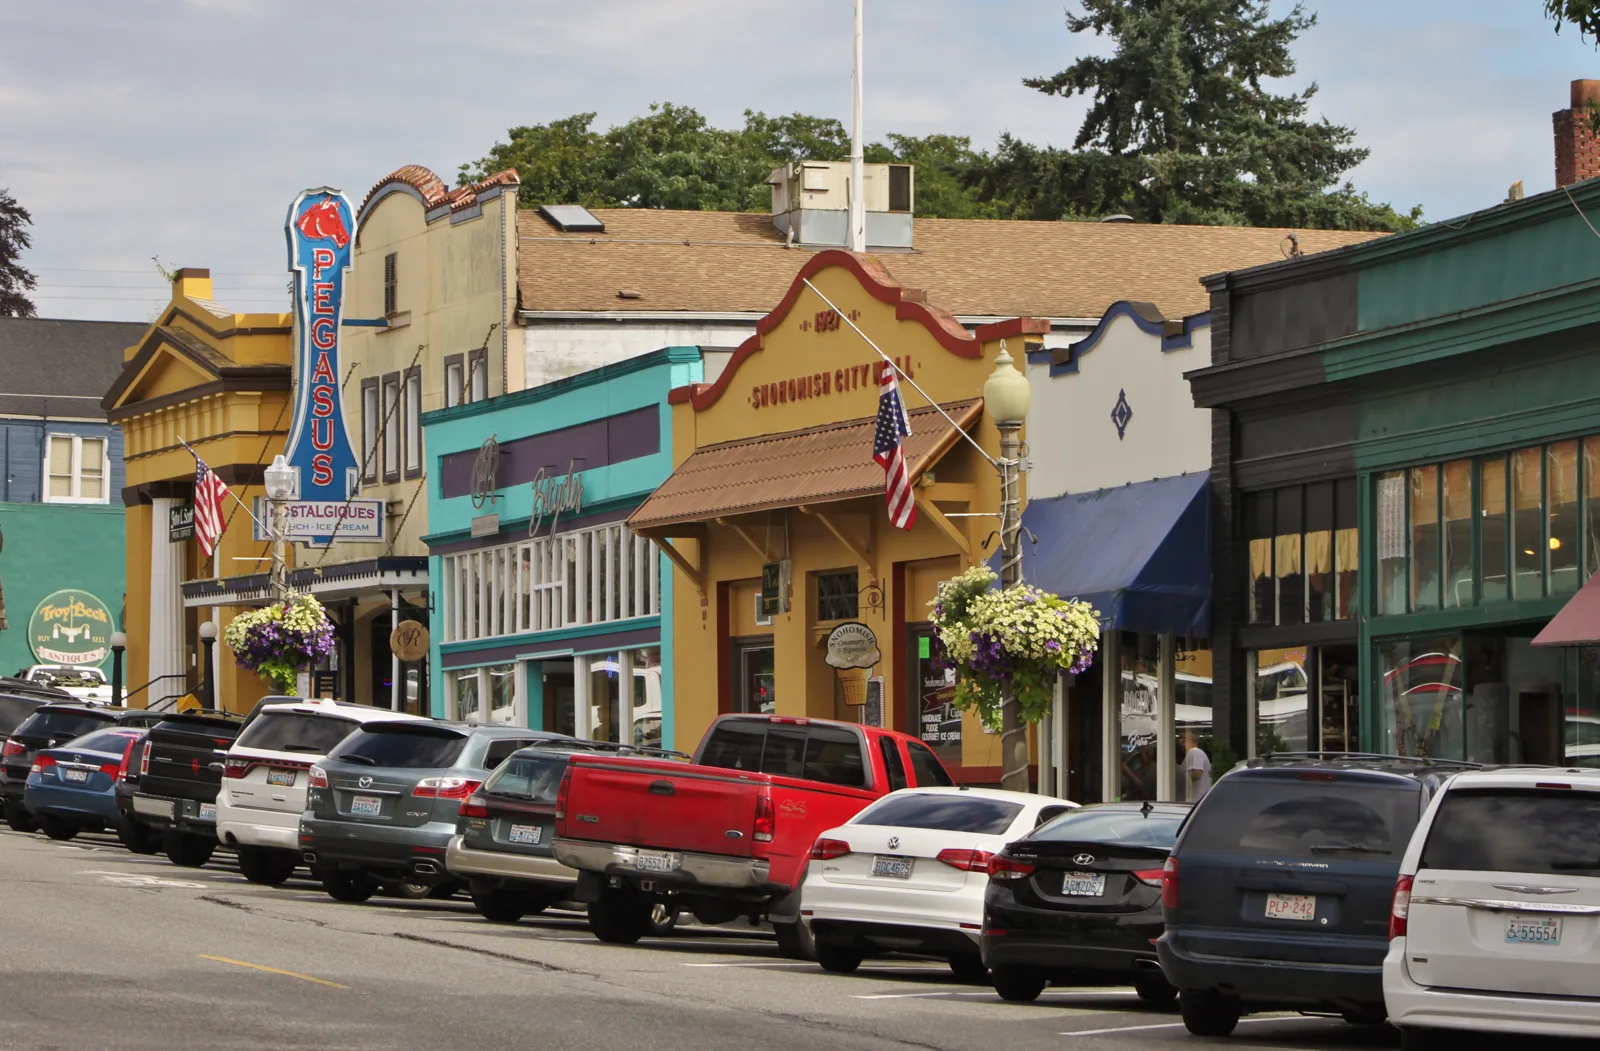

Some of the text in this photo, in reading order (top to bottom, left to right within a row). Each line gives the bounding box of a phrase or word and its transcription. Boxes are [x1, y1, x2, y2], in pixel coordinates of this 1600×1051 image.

[310, 247, 337, 486] PEGASUS
[752, 355, 914, 410] SNOHOMISH CITY HLL
[529, 459, 584, 554] Bicycles
[336, 522, 370, 531] CREAM
[40, 601, 108, 623] Troy Beck
[829, 626, 875, 648] SNOHOMISH
[47, 652, 97, 663] ANTIQUES
[925, 723, 939, 732] FUDGE
[1064, 880, 1103, 893] ARM2067
[1525, 903, 1587, 911] COUNTRY
[1520, 925, 1558, 942] 55554
